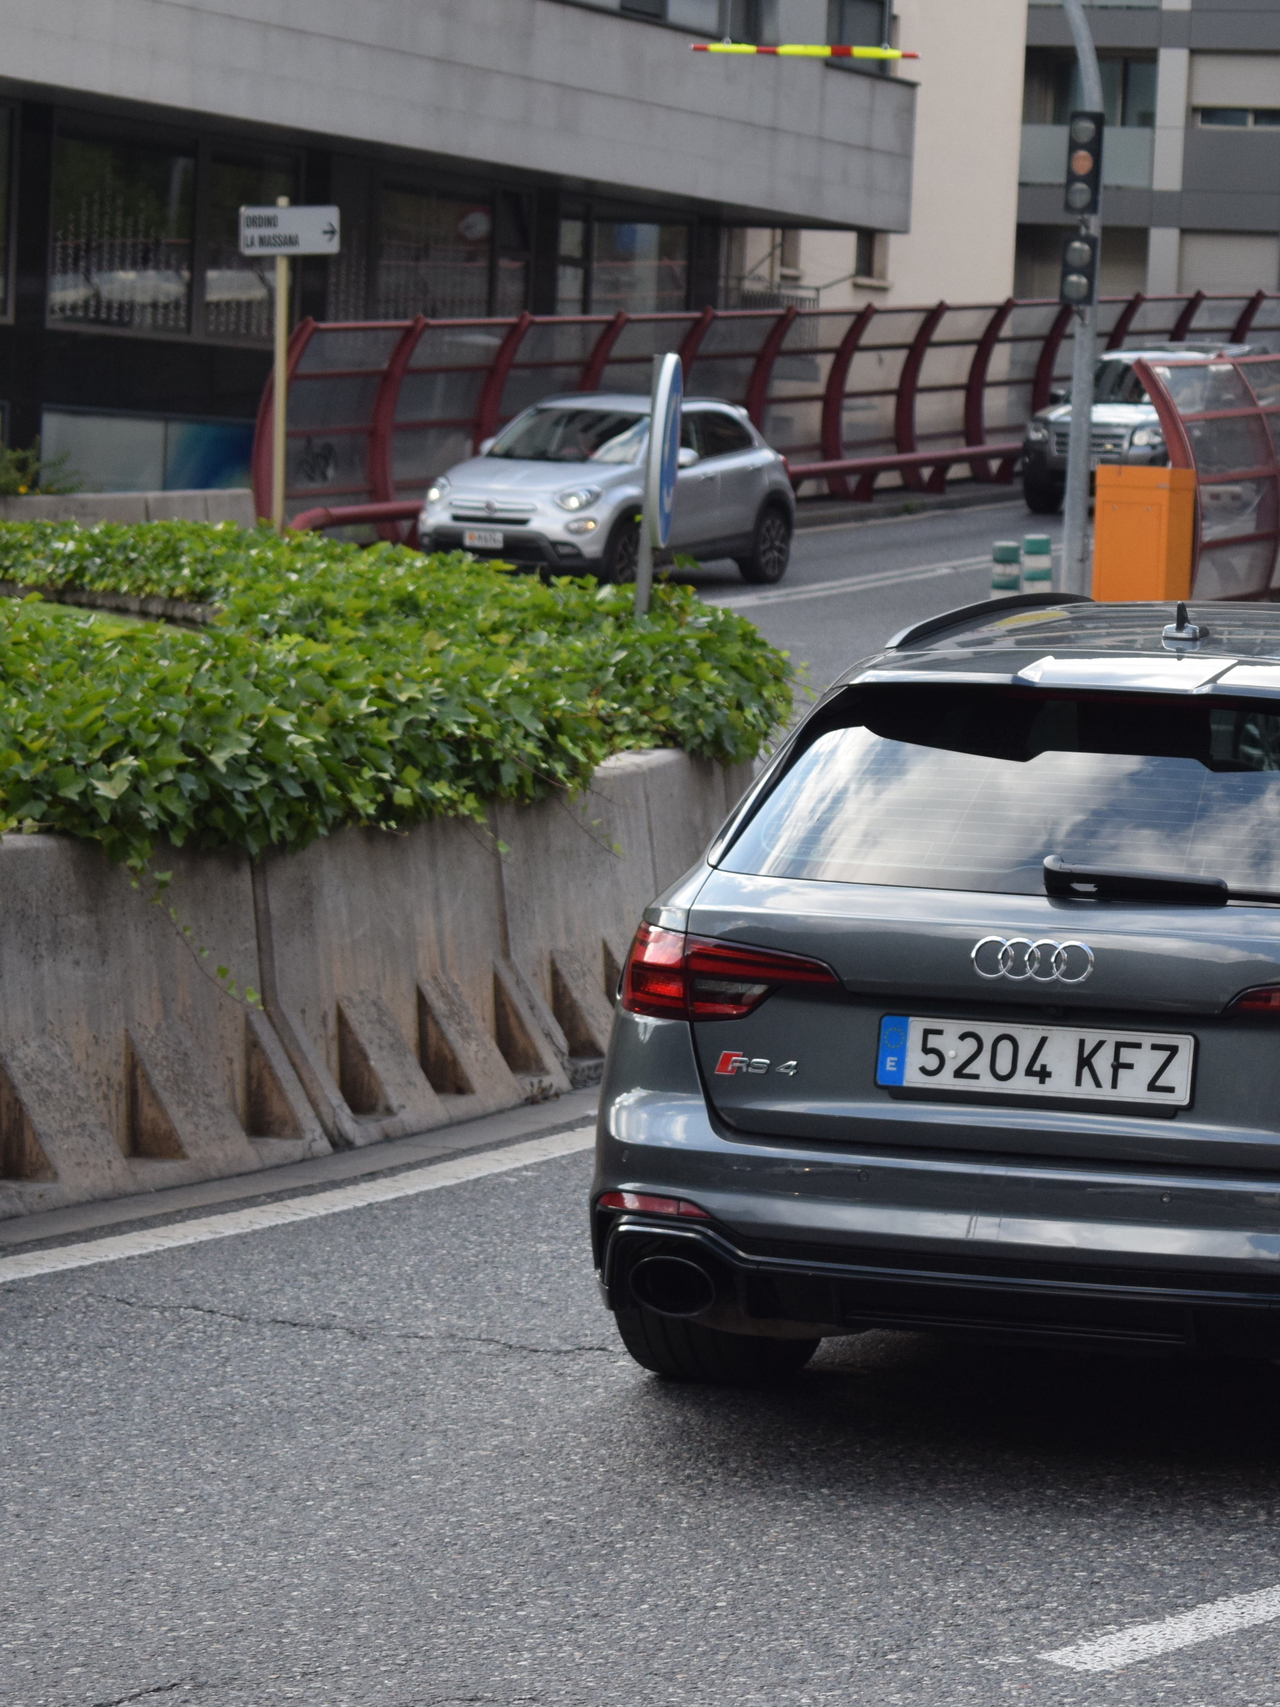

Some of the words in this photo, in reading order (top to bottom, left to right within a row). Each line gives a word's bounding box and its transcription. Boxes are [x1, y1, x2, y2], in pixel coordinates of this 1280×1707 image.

[245, 214, 278, 228] ORDINO
[245, 235, 256, 248] LA
[258, 234, 299, 247] MASSANA
[724, 1055, 771, 1074] RS
[775, 1060, 798, 1077] 4
[885, 1057, 898, 1071] E
[919, 1028, 1053, 1085] 5204
[1075, 1038, 1180, 1094] KFZ
